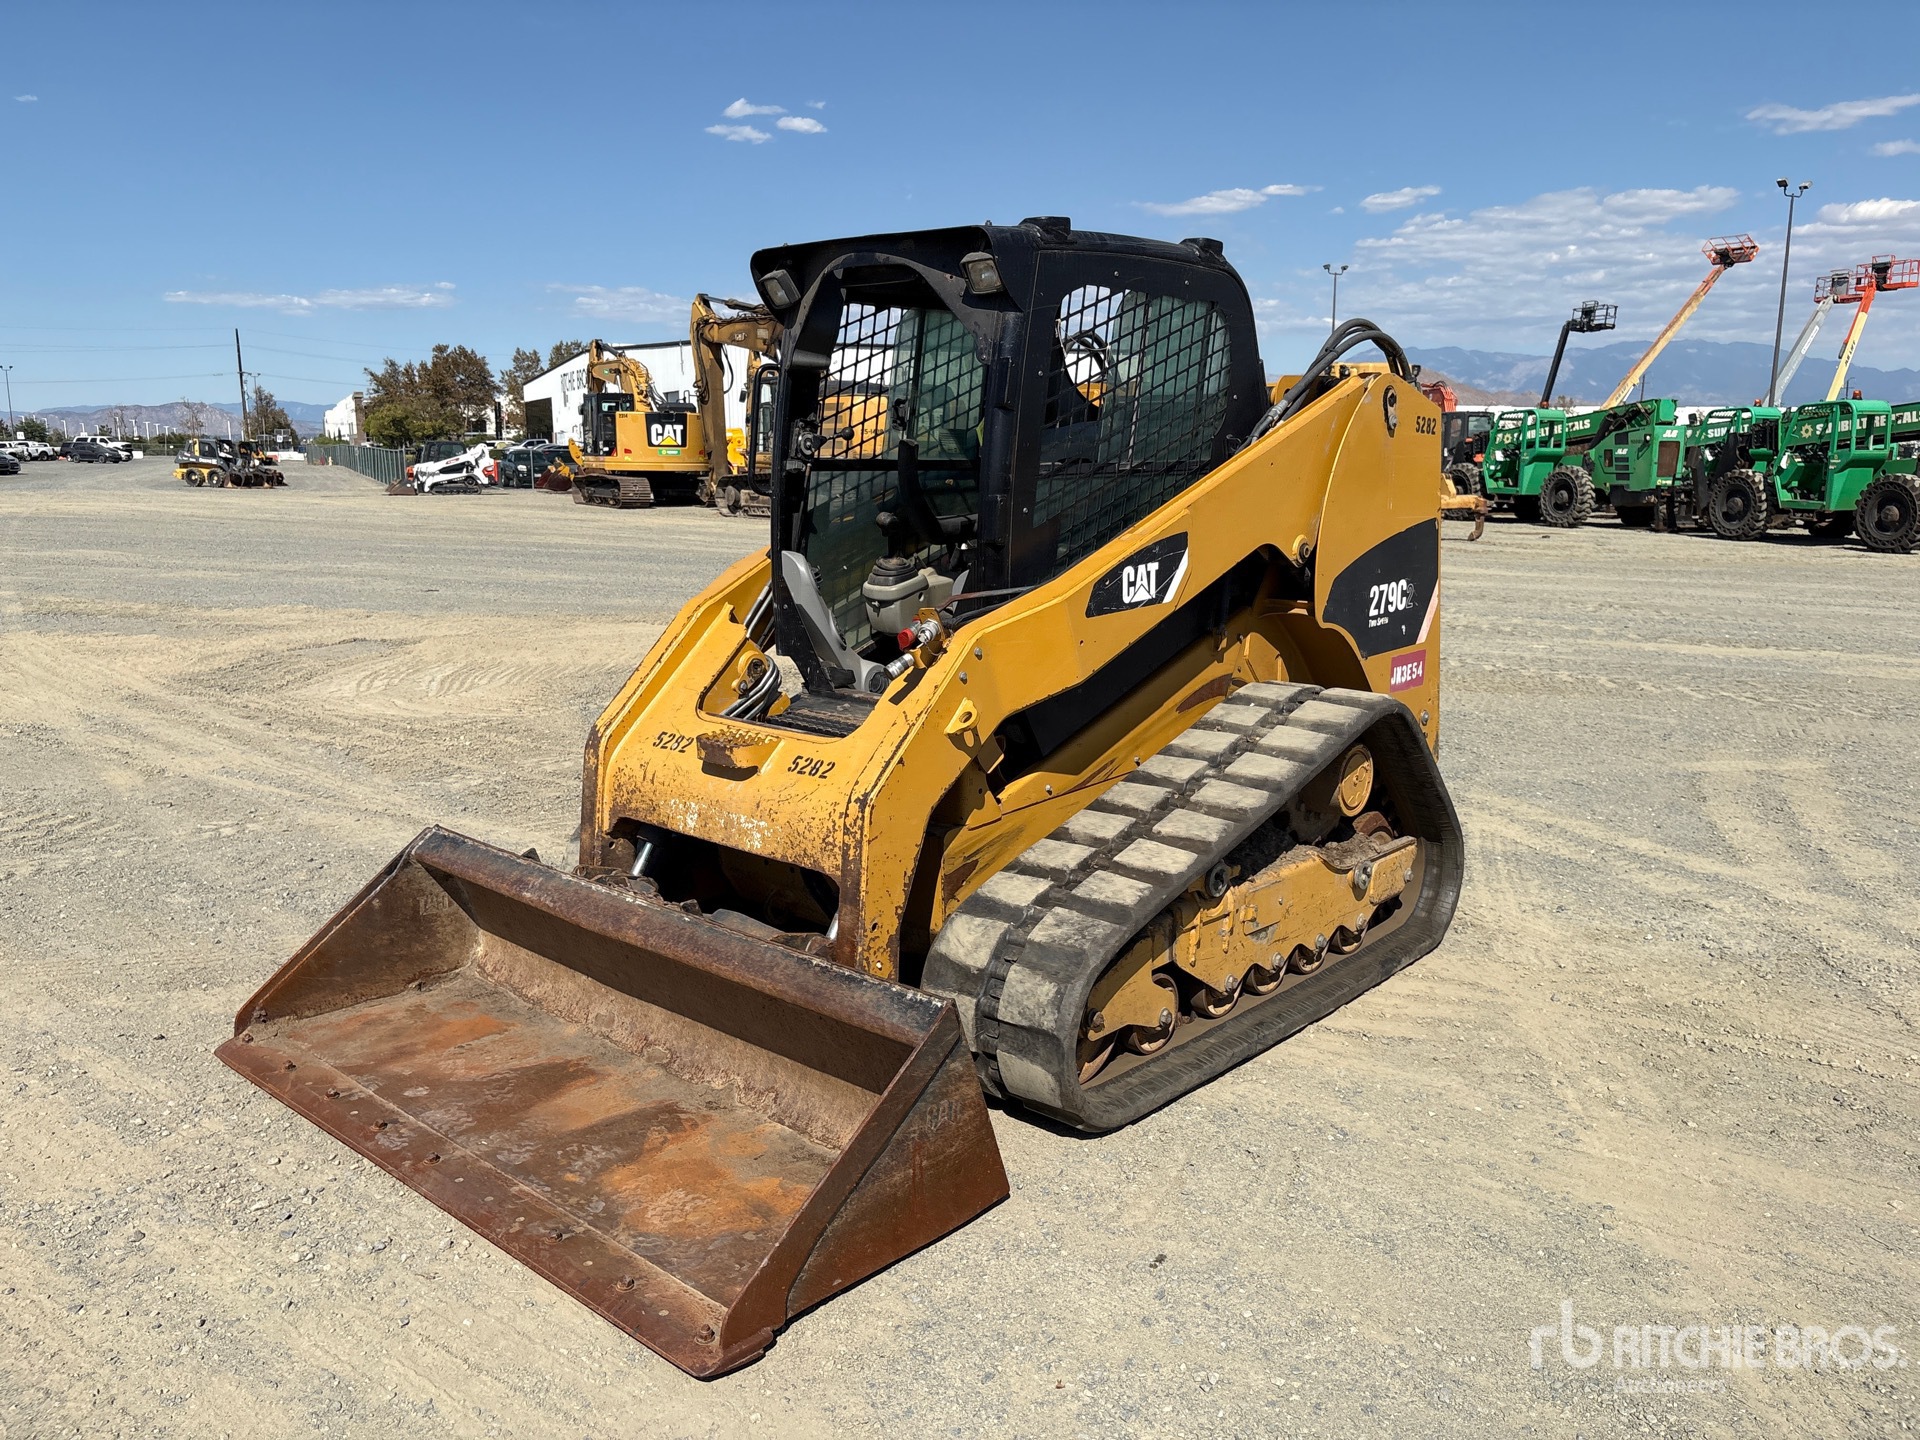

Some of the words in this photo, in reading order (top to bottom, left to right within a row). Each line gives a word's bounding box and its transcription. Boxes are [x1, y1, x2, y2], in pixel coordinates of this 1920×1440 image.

[650, 423, 684, 446] CAT
[1415, 415, 1437, 435] 5282
[1122, 561, 1159, 604] CAT
[652, 731, 694, 754] 5282
[787, 755, 836, 780] 5282
